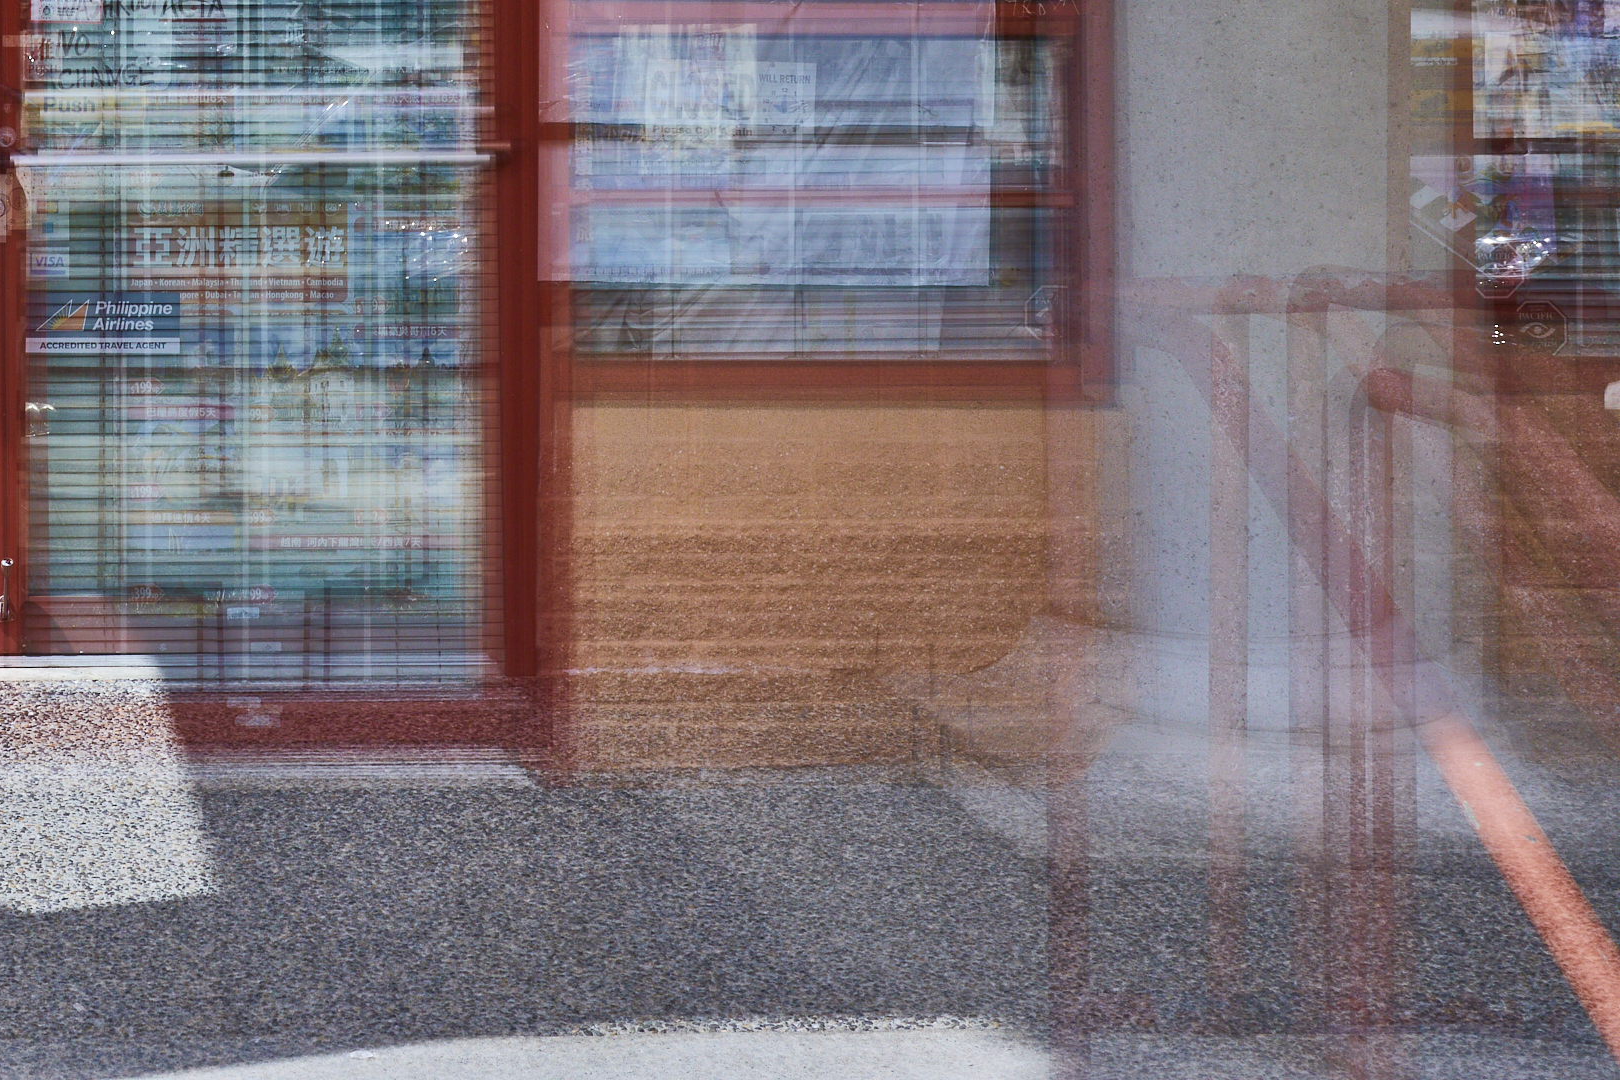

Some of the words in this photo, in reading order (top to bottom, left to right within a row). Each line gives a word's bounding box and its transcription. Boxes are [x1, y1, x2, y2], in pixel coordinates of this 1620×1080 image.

[758, 73, 778, 84] WILL
[779, 73, 811, 84] RETURN
[649, 70, 758, 121] CLOSED
[43, 95, 96, 113] Push
[652, 124, 692, 135] Please
[133, 225, 346, 269] 亞洲精選遊
[35, 256, 65, 268] VISA
[130, 278, 153, 288] Japan
[159, 278, 186, 287] Korean
[191, 278, 225, 288] Malaysia
[268, 278, 301, 287] Vietnam
[306, 277, 344, 287] Cambodia
[205, 290, 227, 299] Dubai
[265, 290, 304, 301] Hongkong
[309, 290, 334, 299] Macao
[94, 300, 173, 318] Philippine
[1518, 311, 1556, 322] PACIFIC
[92, 317, 154, 331] Airlines
[39, 341, 97, 350] ACCREDITED
[98, 341, 134, 350] TRAVEL
[135, 341, 167, 350] AGENT
